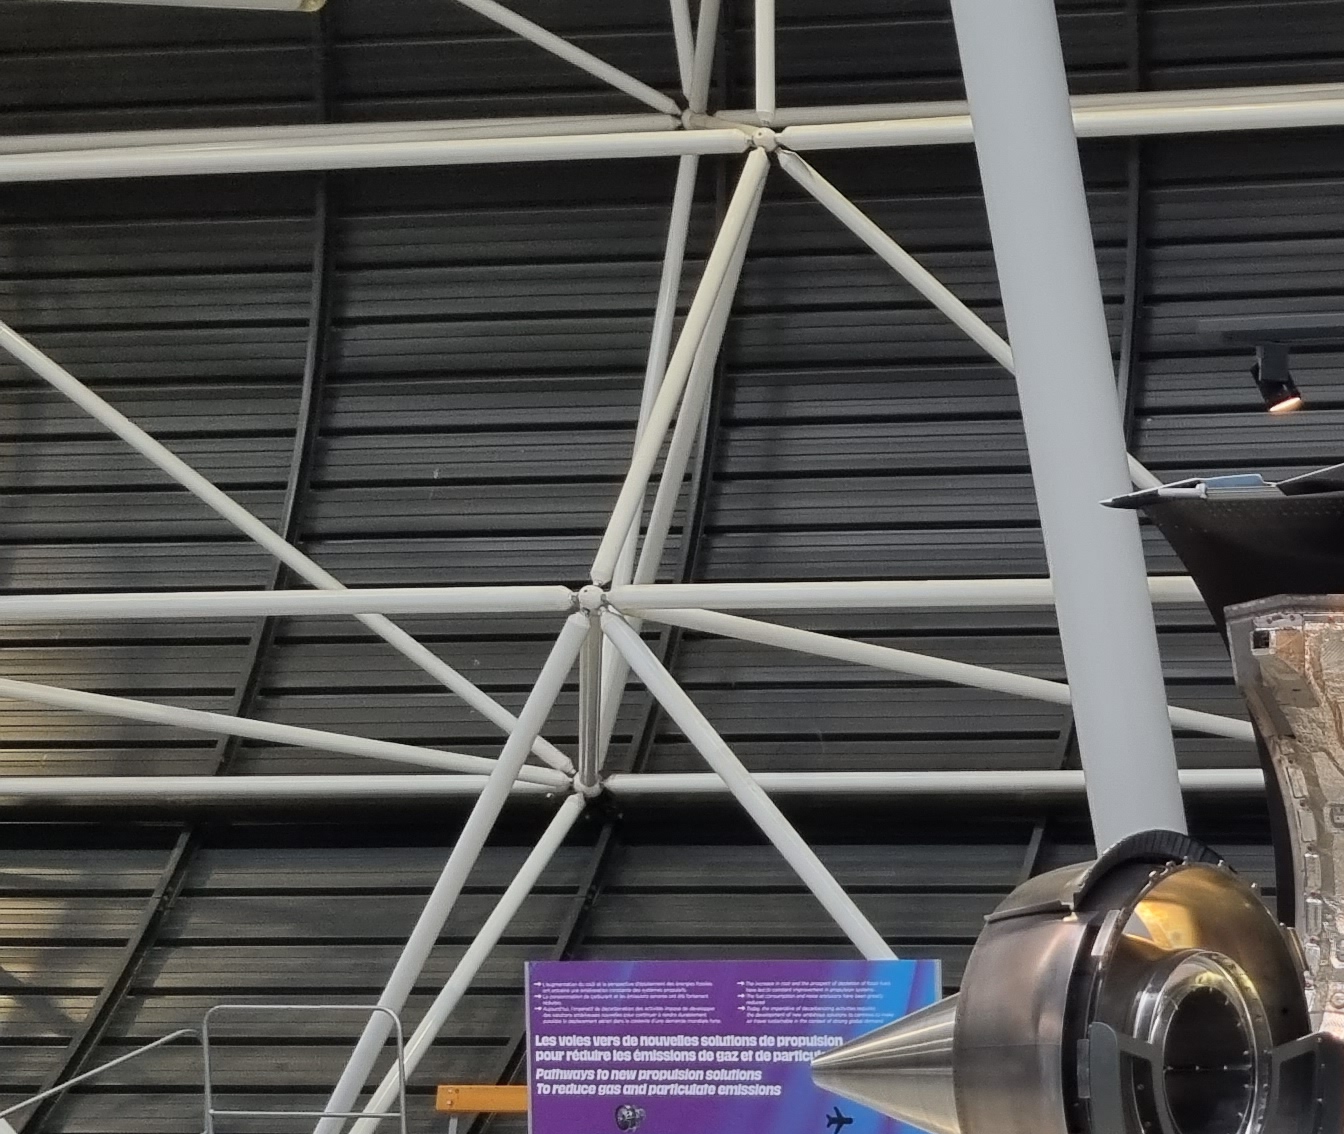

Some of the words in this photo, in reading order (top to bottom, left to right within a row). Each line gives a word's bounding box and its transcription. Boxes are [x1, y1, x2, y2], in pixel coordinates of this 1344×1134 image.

[535, 1034, 557, 1047] Les
[558, 1034, 592, 1047] voies
[592, 1035, 620, 1047] vers
[622, 1034, 638, 1047] de
[640, 1034, 699, 1047] nouvelles
[701, 1034, 757, 1047] solutions
[759, 1034, 775, 1047] de
[776, 1034, 844, 1048] propulsion
[535, 1050, 564, 1062] pour
[566, 1049, 611, 1061] réduire
[612, 1049, 631, 1061] les
[633, 1048, 696, 1061] émissions
[698, 1049, 714, 1061] de
[716, 1050, 739, 1062] gaz
[740, 1049, 753, 1061] et
[755, 1050, 772, 1061] de
[535, 1068, 595, 1081] Pathways
[596, 1068, 609, 1080] to
[610, 1069, 637, 1080] new
[638, 1068, 704, 1082] propulsion
[705, 1068, 762, 1081] solutions
[537, 1083, 551, 1095] To
[552, 1083, 596, 1095] reduce
[598, 1084, 621, 1096] gas
[623, 1083, 647, 1095] and
[648, 1083, 716, 1096] particulate
[718, 1083, 782, 1096] emissions
